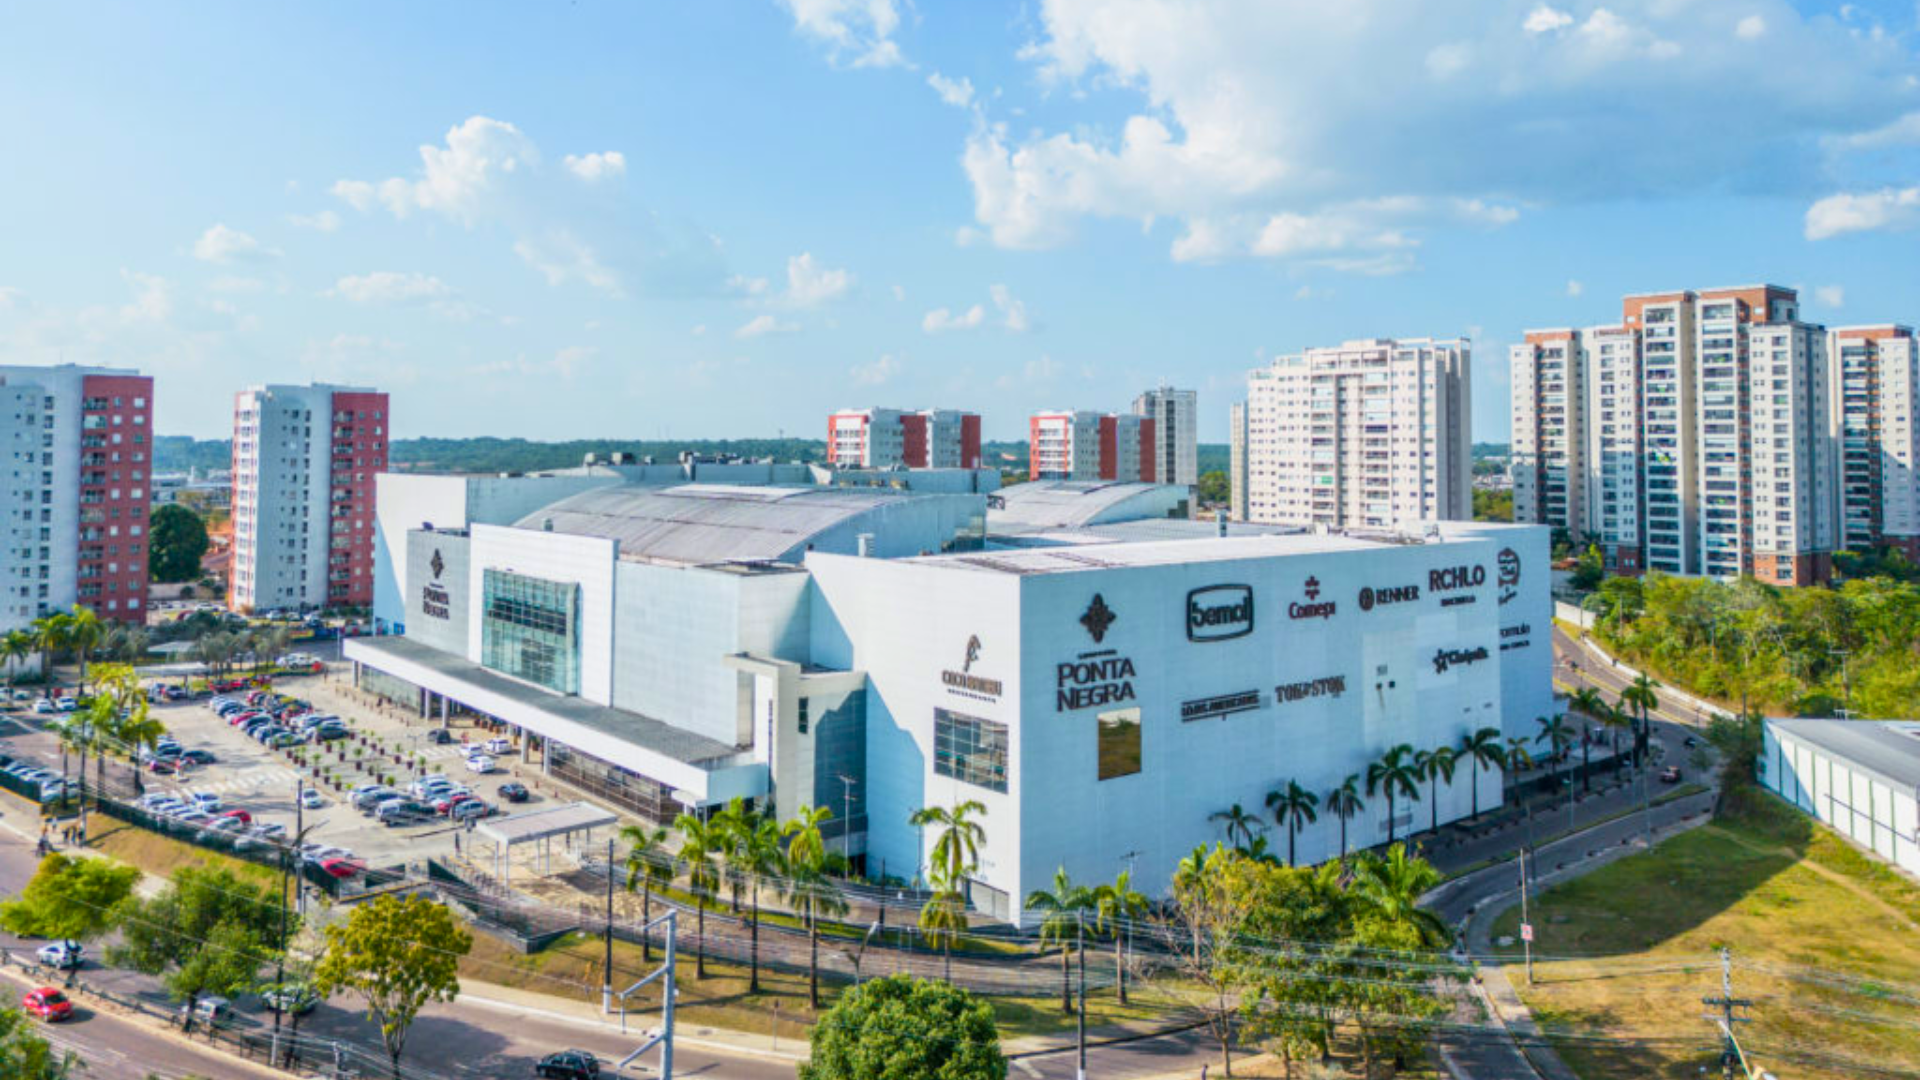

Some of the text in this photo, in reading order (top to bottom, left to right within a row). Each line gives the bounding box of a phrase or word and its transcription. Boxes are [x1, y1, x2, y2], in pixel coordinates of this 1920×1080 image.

[1429, 565, 1486, 592] RCHLO
[1376, 586, 1420, 605] RENNER
[1057, 658, 1136, 688] PONTA
[1057, 681, 1136, 712] NEGRA
